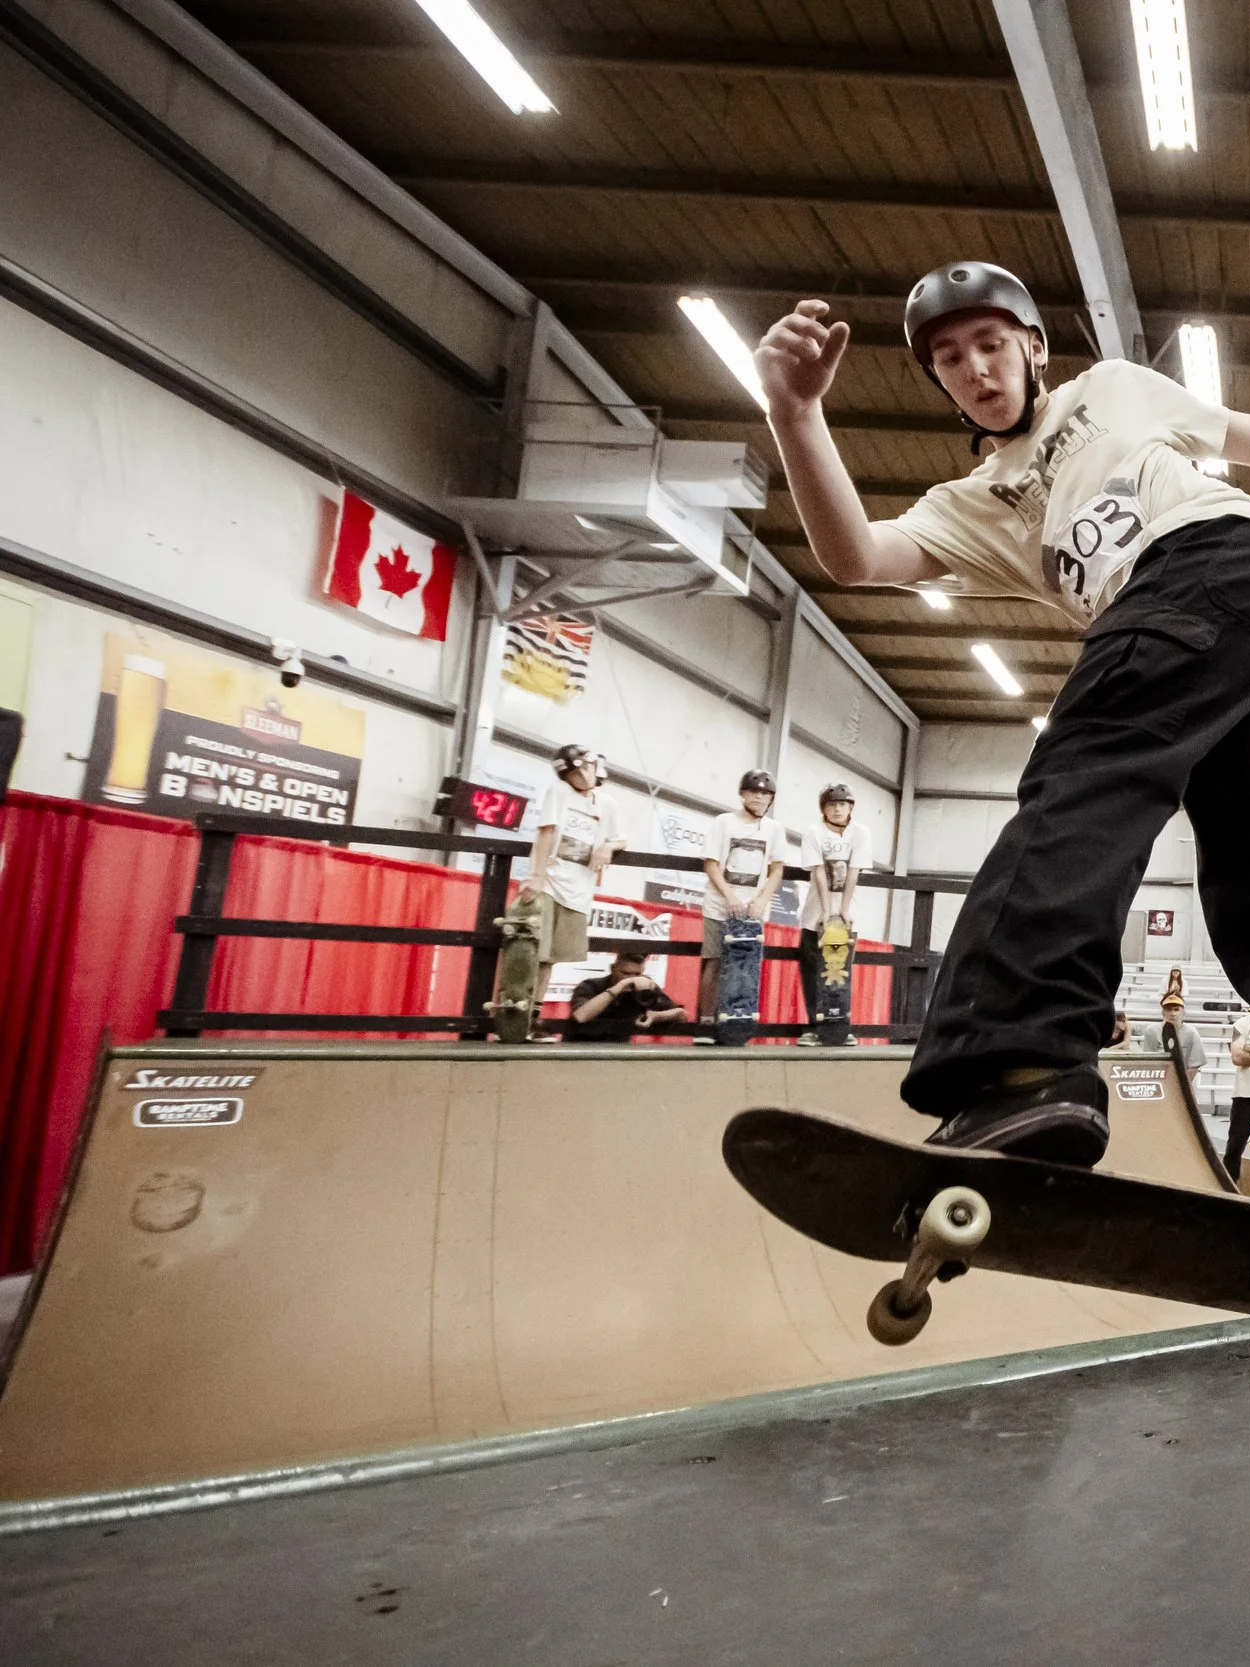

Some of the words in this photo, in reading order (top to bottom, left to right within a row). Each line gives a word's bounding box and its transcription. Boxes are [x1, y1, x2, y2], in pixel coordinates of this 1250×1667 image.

[1055, 499, 1143, 596] 303
[244, 713, 299, 741] SLEEMAN
[185, 735, 256, 760] PROUDLY
[256, 752, 340, 780] SPONSORING
[165, 752, 256, 786] MEN'S
[258, 773, 280, 792] &
[282, 777, 349, 806] OPEN
[124, 1069, 257, 1089] SKATELITE
[1110, 1066, 1167, 1079] SKATELITE
